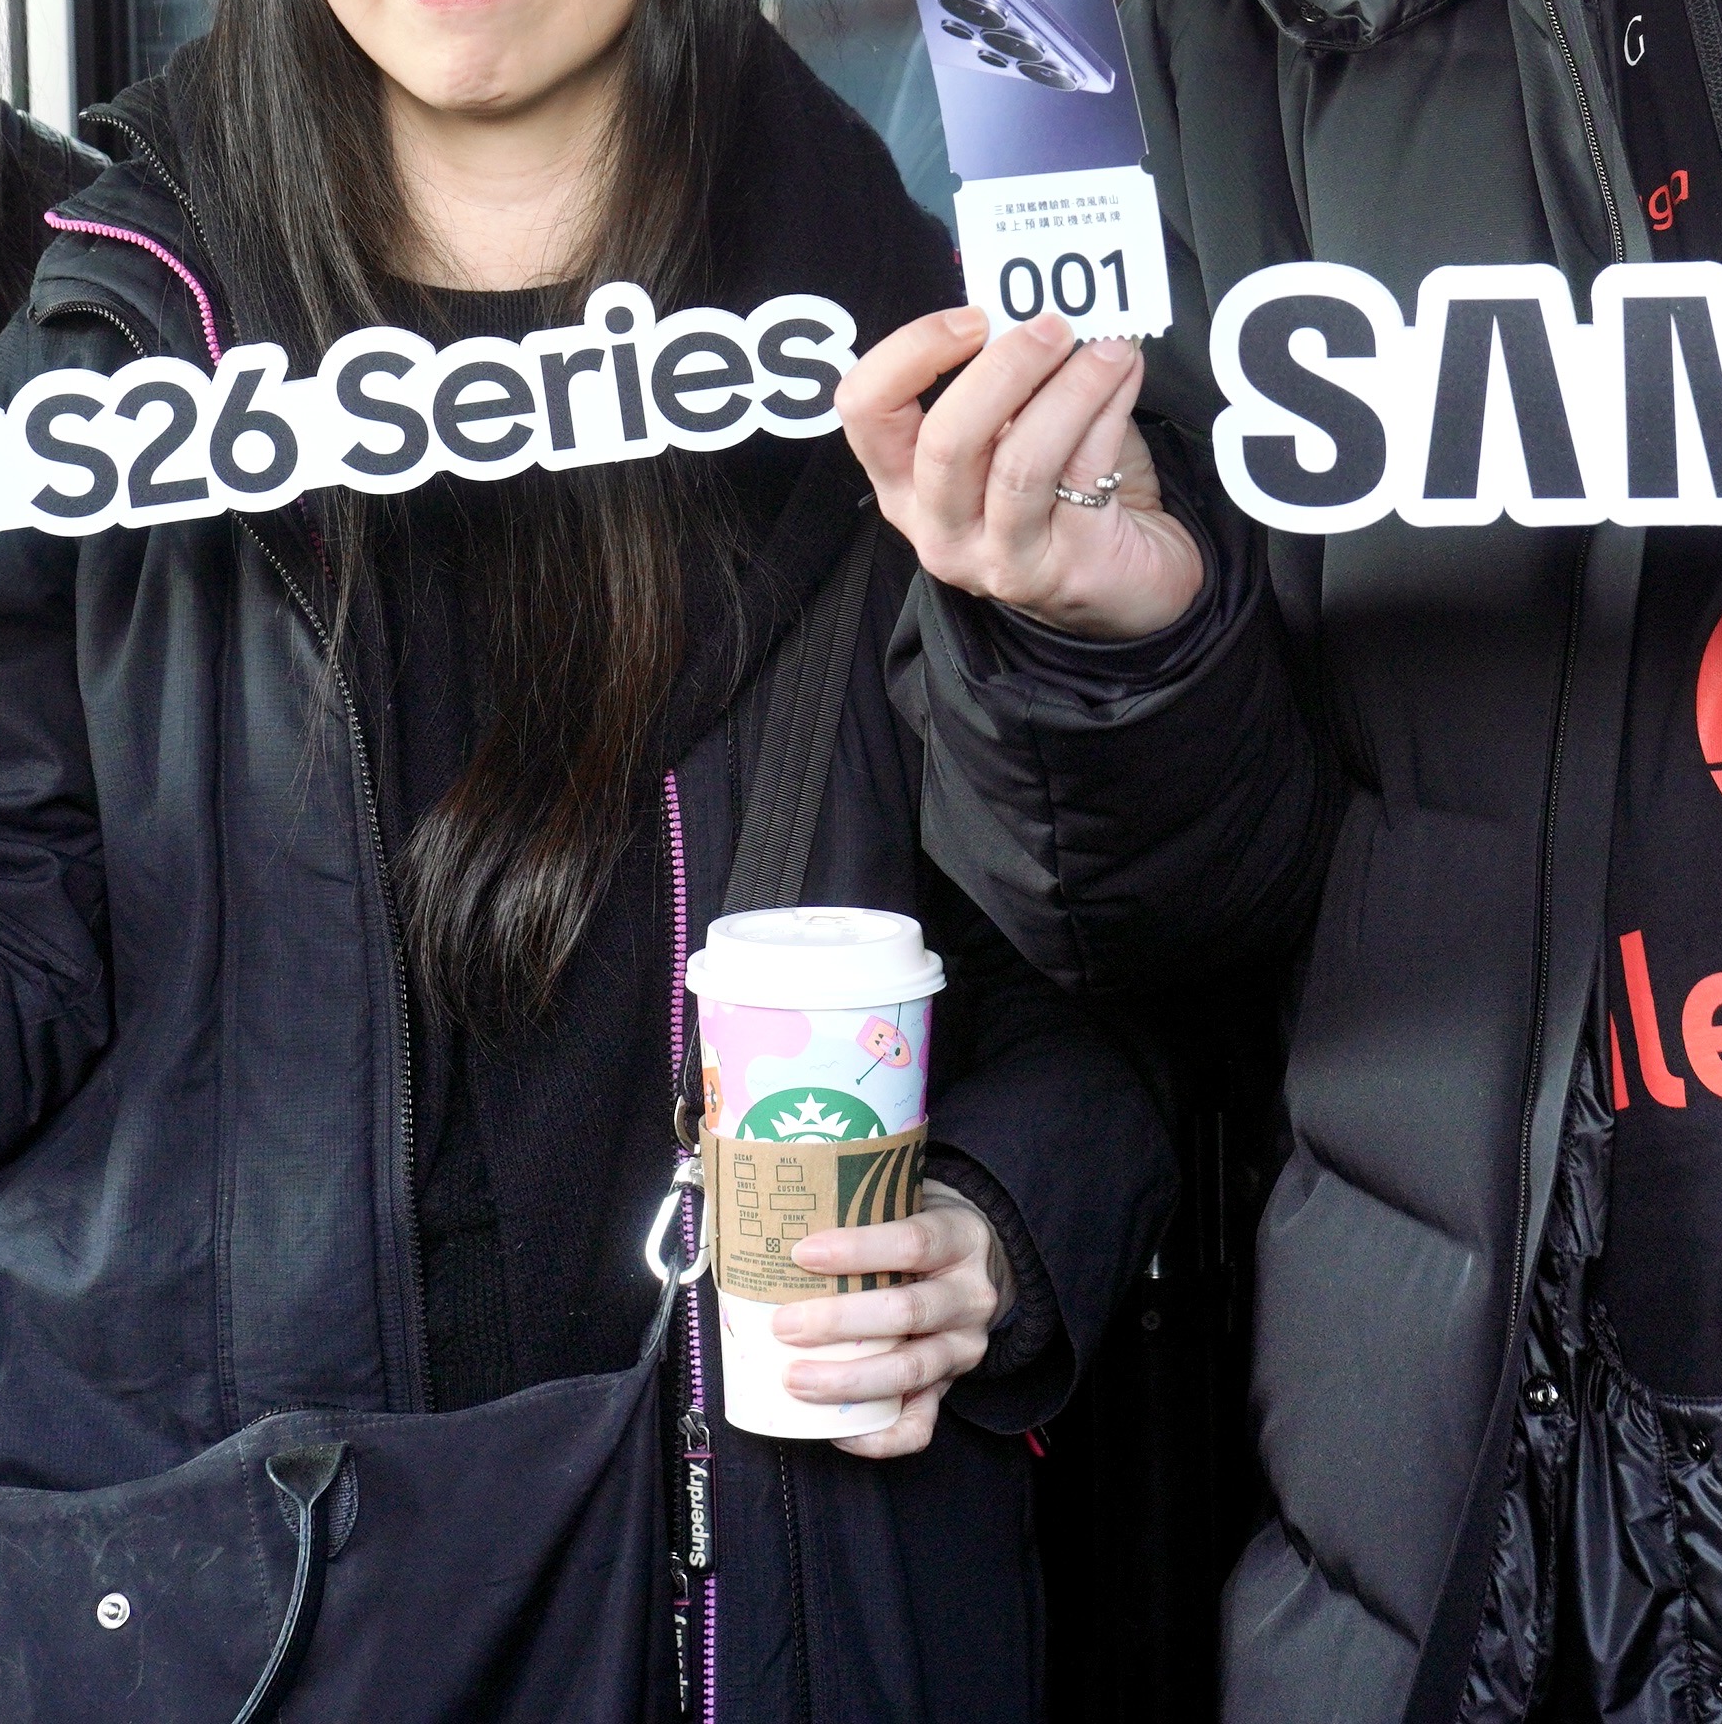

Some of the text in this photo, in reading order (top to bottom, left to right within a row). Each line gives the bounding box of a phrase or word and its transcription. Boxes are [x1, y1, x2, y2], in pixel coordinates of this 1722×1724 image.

[1000, 249, 1129, 322] 001
[27, 369, 299, 519] S26
[340, 305, 842, 477] Series
[733, 1153, 754, 1162] DECAF
[737, 1181, 756, 1190] SHOTS
[777, 1185, 807, 1193] CUSTOM
[739, 1210, 759, 1220] SYRUP
[782, 1214, 806, 1222] DRINK
[686, 1462, 710, 1568] Superdry
